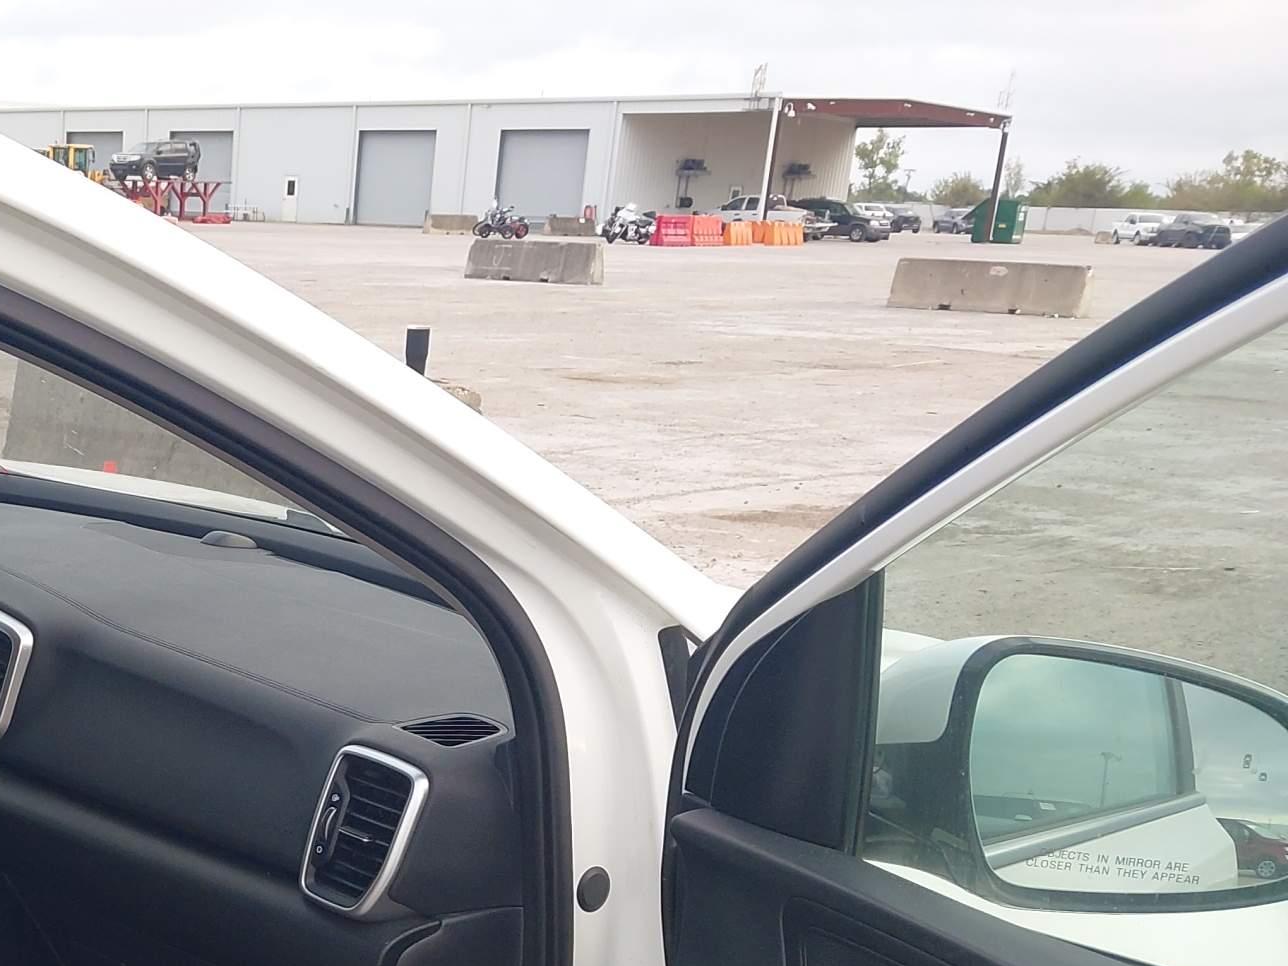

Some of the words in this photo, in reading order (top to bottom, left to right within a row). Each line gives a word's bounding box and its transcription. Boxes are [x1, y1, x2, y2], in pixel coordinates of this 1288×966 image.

[1026, 858, 1072, 871] CLOSER
[1079, 863, 1110, 875] THAN
[1116, 867, 1147, 880] THEY
[1152, 871, 1200, 885] APPEAR
[1097, 854, 1110, 864] IN
[1115, 855, 1161, 870] MIRROR
[1165, 861, 1189, 873] ARE
